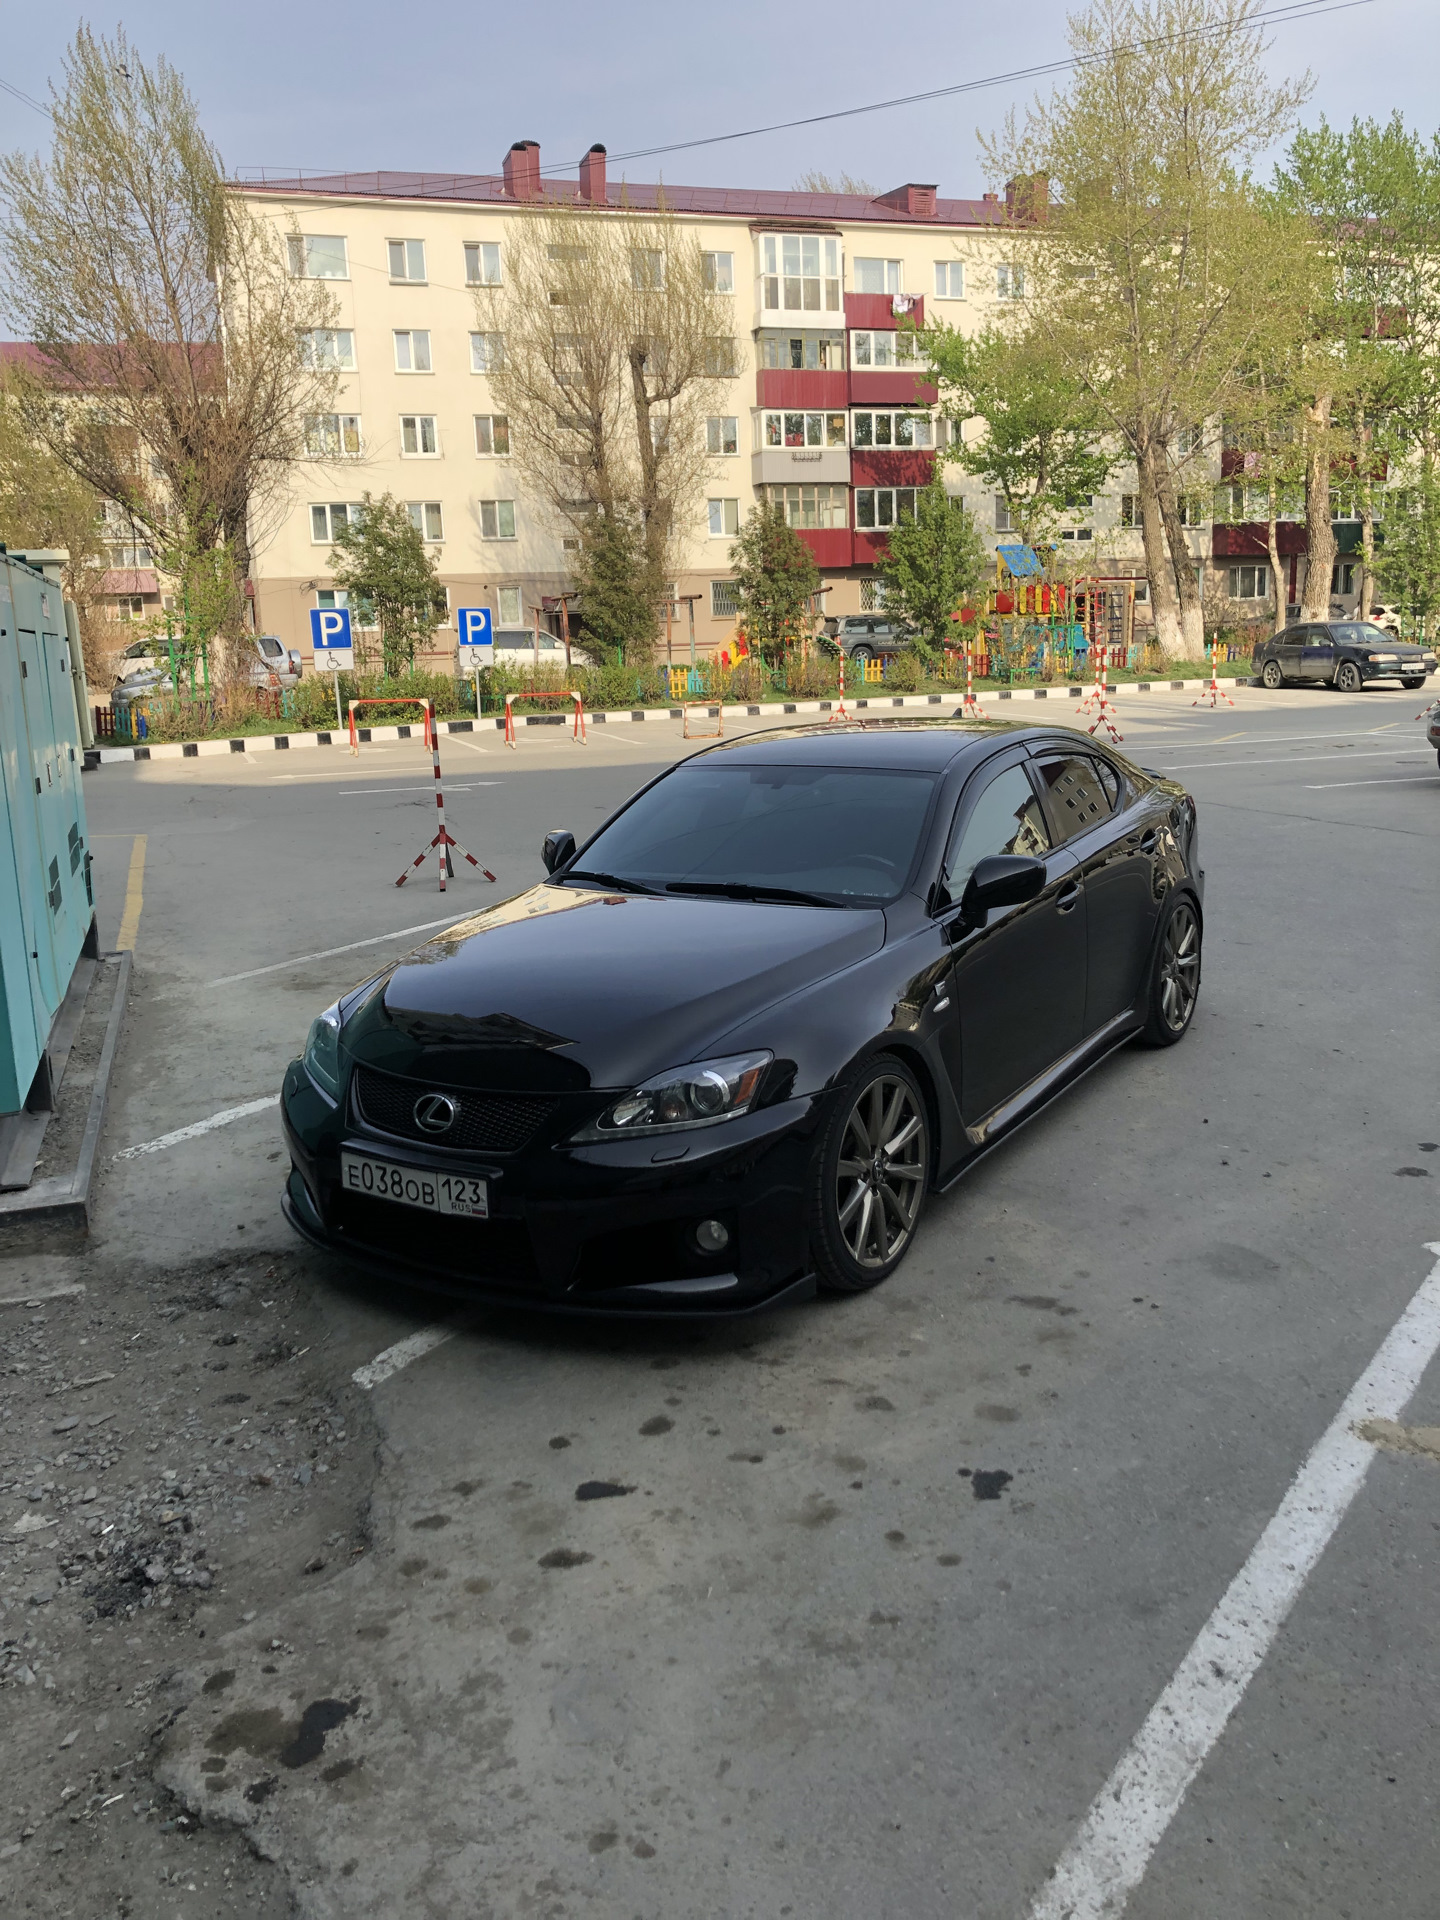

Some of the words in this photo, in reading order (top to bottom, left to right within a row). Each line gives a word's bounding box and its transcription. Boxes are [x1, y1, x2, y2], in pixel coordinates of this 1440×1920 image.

[319, 612, 343, 646] P
[466, 611, 486, 643] P
[441, 1178, 481, 1205] 123
[451, 1202, 471, 1214] RUS
